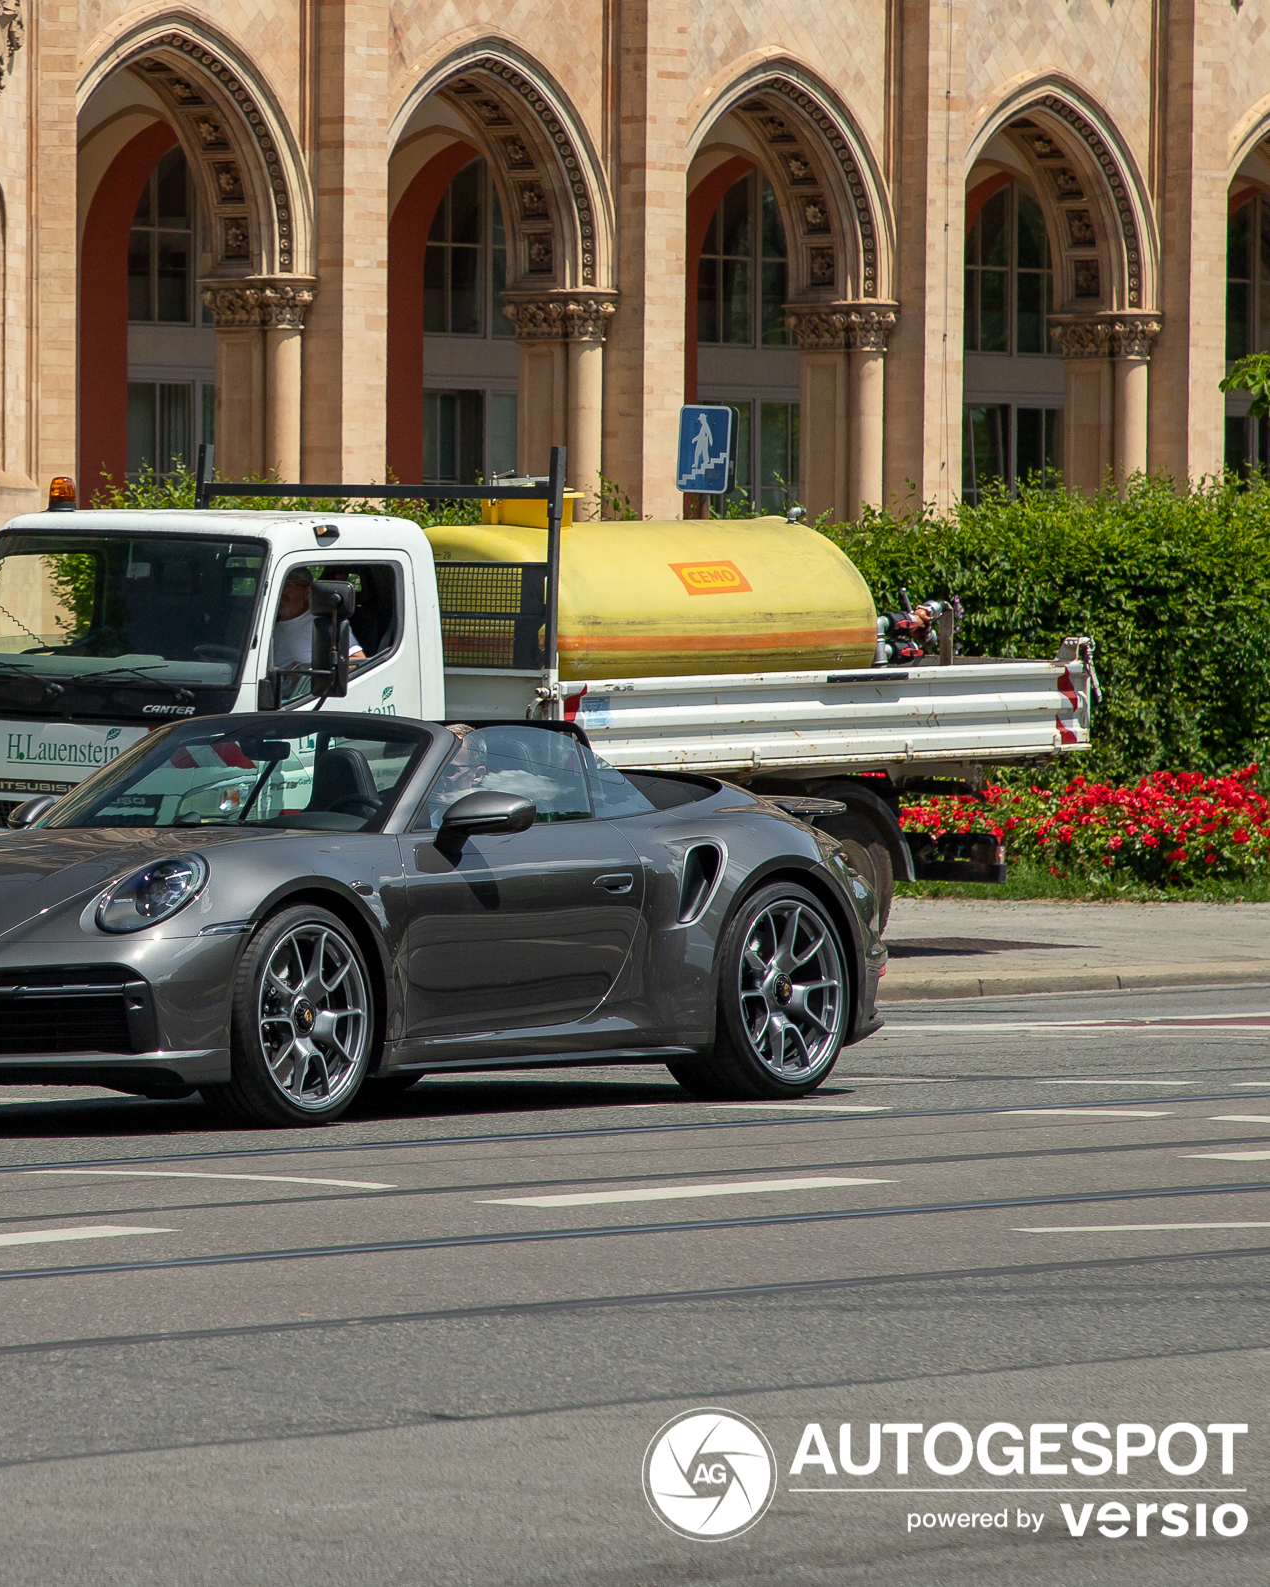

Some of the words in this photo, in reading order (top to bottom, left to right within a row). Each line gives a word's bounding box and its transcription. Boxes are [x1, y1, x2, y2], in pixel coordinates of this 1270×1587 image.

[687, 569, 736, 584] CEMO
[142, 704, 196, 715] CANTER
[6, 733, 120, 763] H.Lauenstein
